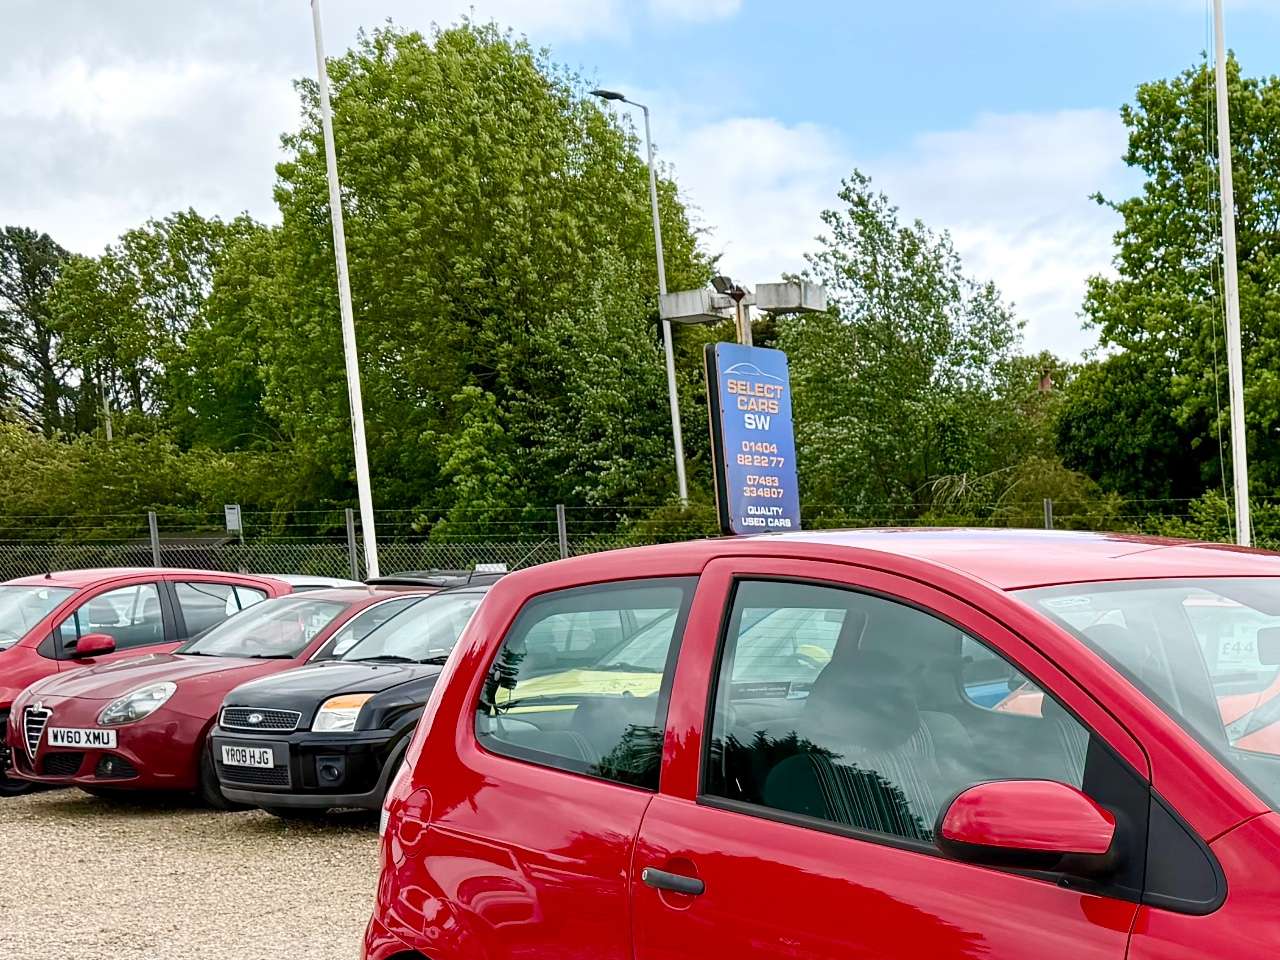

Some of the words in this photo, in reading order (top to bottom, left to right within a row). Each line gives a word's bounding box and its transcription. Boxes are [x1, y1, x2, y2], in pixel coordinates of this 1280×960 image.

[727, 379, 784, 399] SELECT
[737, 396, 779, 414] CARS
[744, 413, 771, 431] SW
[742, 441, 778, 455] 01404
[747, 506, 783, 516] QUALITY
[742, 517, 766, 527] USED
[768, 518, 792, 528] CARS
[52, 729, 81, 744] WV60
[84, 731, 110, 745] XMU
[225, 747, 247, 763] YR08
[249, 749, 269, 765] HJG
